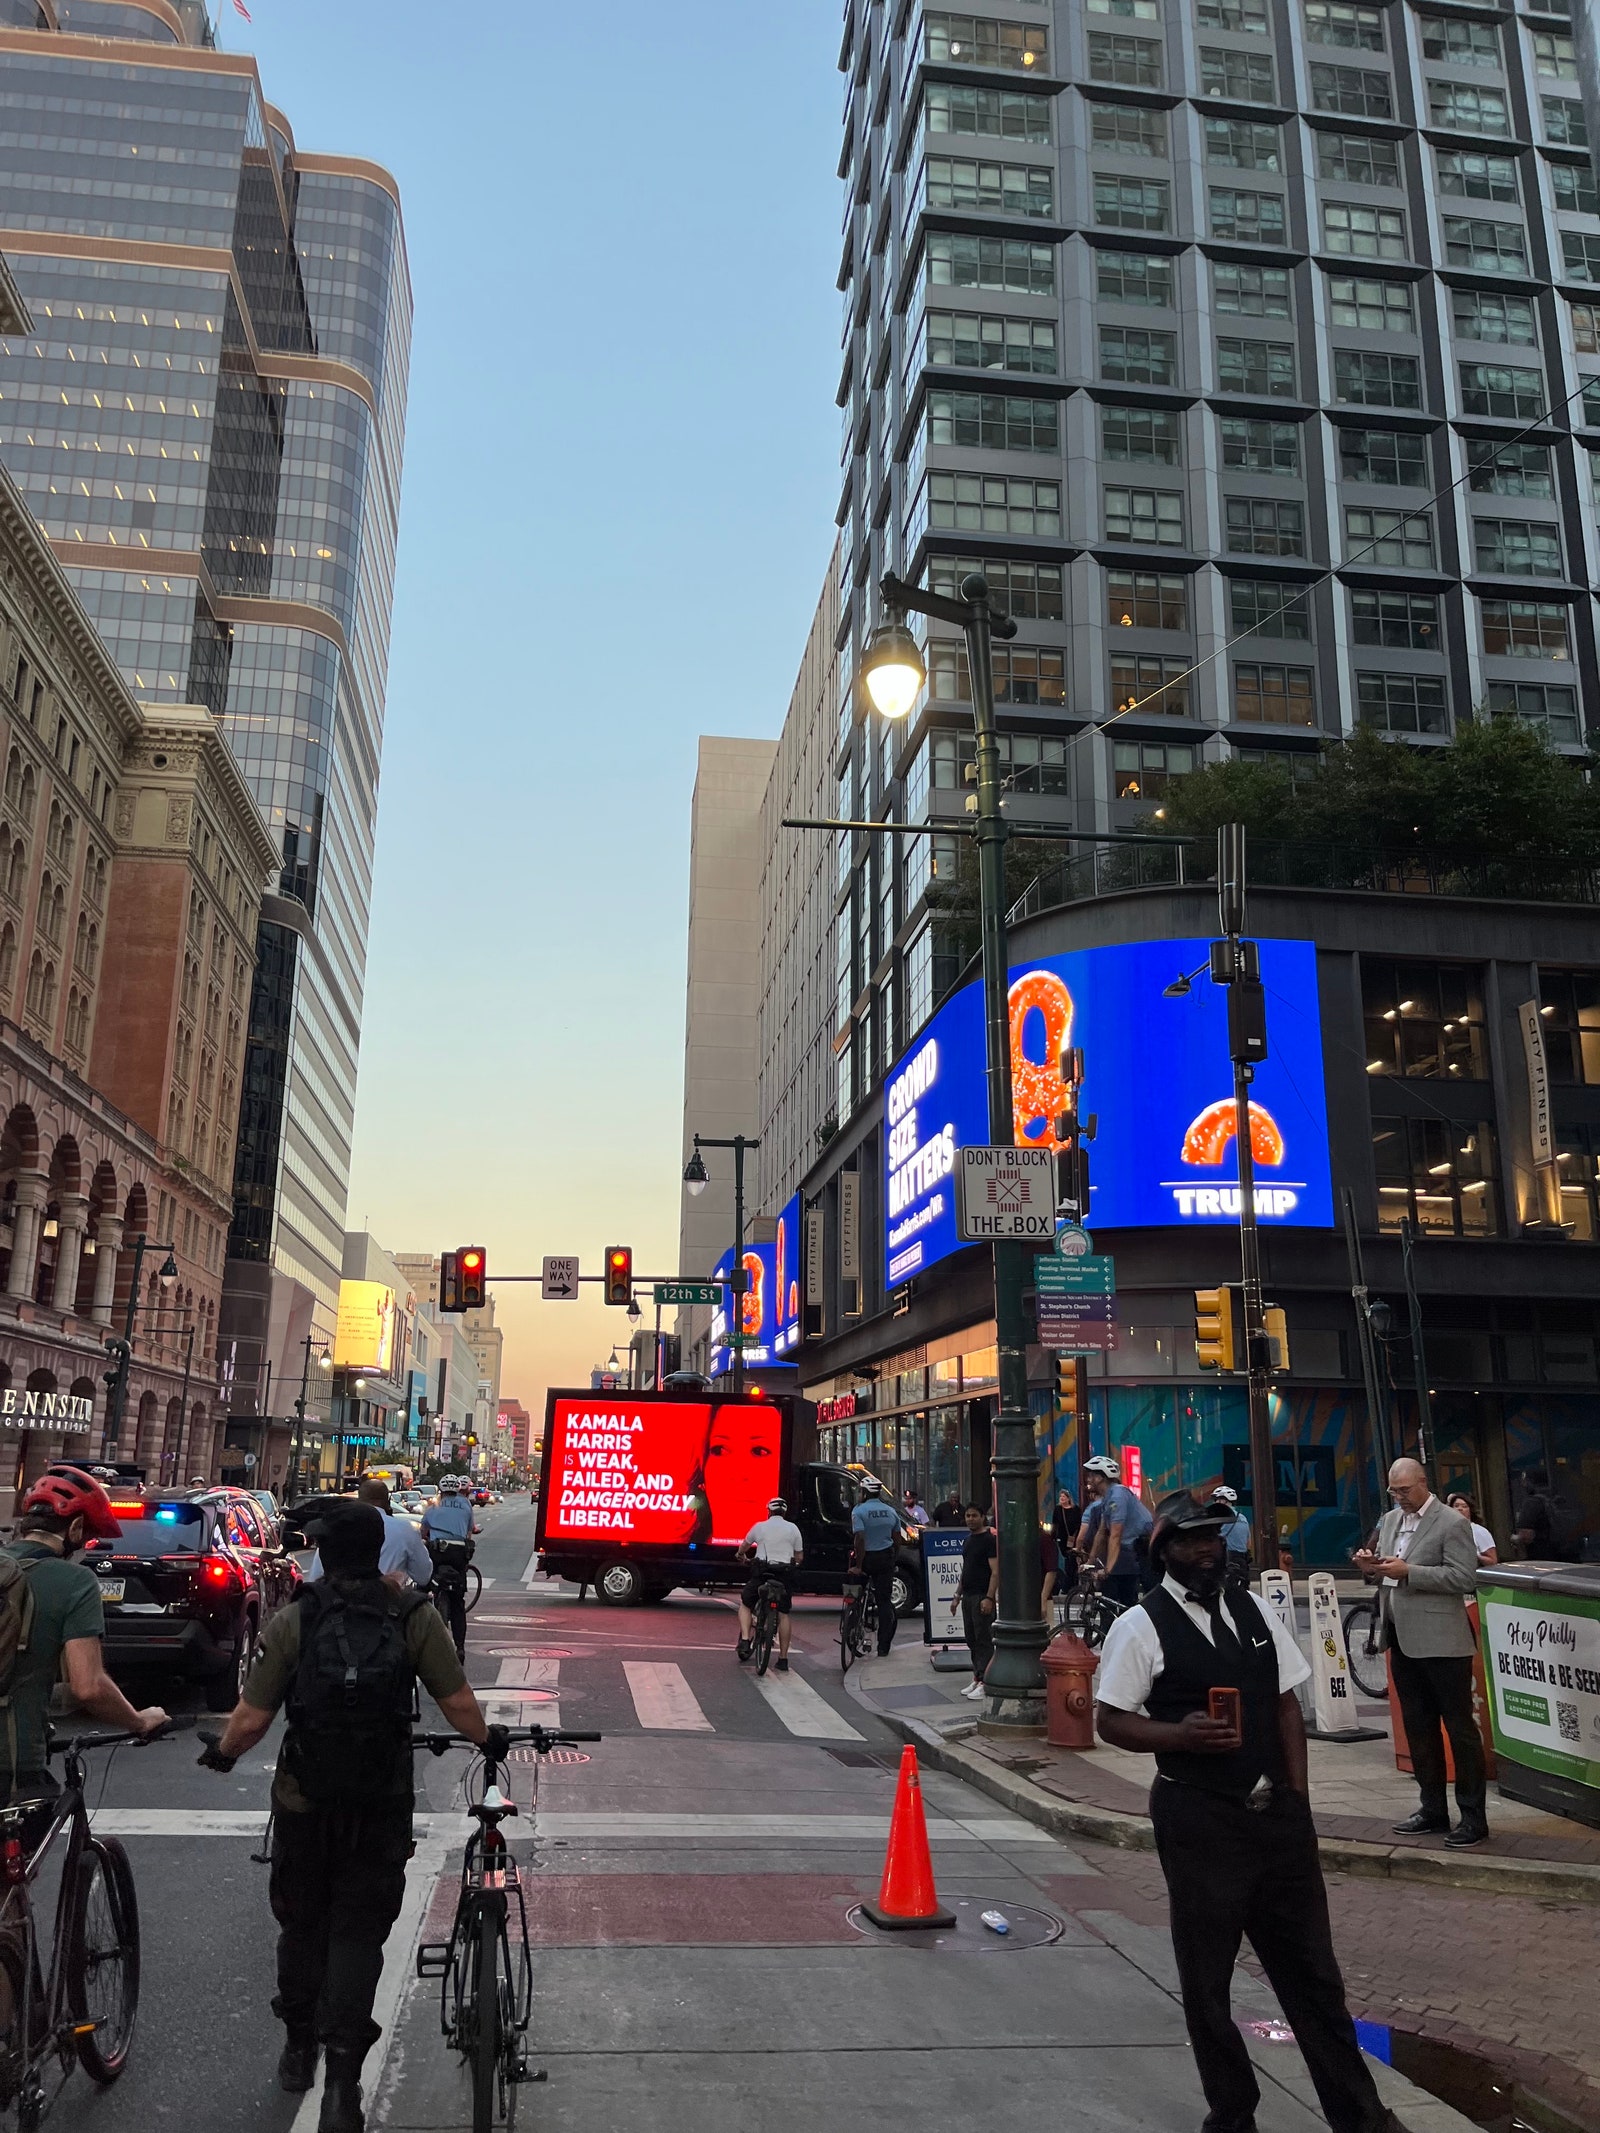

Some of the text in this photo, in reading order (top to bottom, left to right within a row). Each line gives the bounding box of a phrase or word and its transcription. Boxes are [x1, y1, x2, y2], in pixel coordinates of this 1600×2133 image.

[889, 1038, 937, 1126] CROWD
[1528, 1017, 1541, 1058] CITY
[1535, 1066, 1548, 1147] FITNESS
[889, 1106, 916, 1171] SIZE
[1007, 1151, 1047, 1166] BLOCK
[889, 1123, 954, 1218] MATTERS
[844, 1184, 852, 1235] FITNESS
[1172, 1188, 1297, 1214] TRUMP
[971, 1216, 1049, 1233] THE BOX
[550, 1260, 572, 1271] ONE
[550, 1271, 573, 1281] WAY
[662, 1288, 715, 1300] 12th St
[1, 1388, 93, 1422] ENNSYL
[567, 1413, 643, 1432] KAMALA
[565, 1432, 632, 1451] HARRIS
[564, 1451, 638, 1473] IS WEAK,
[562, 1470, 673, 1492] FAILED, AND
[560, 1490, 695, 1511] DANGEROUSLY
[559, 1509, 634, 1529] LIBERAL
[868, 1509, 889, 1519] POLICE
[931, 1562, 958, 1574] PUBLIC
[1507, 1620, 1576, 1652] Hey Philly
[1498, 1651, 1512, 1675] BE
[1513, 1654, 1546, 1683] GREEN
[1548, 1664, 1557, 1686] &
[1558, 1664, 1574, 1690] BE
[1330, 1677, 1347, 1698] BEE
